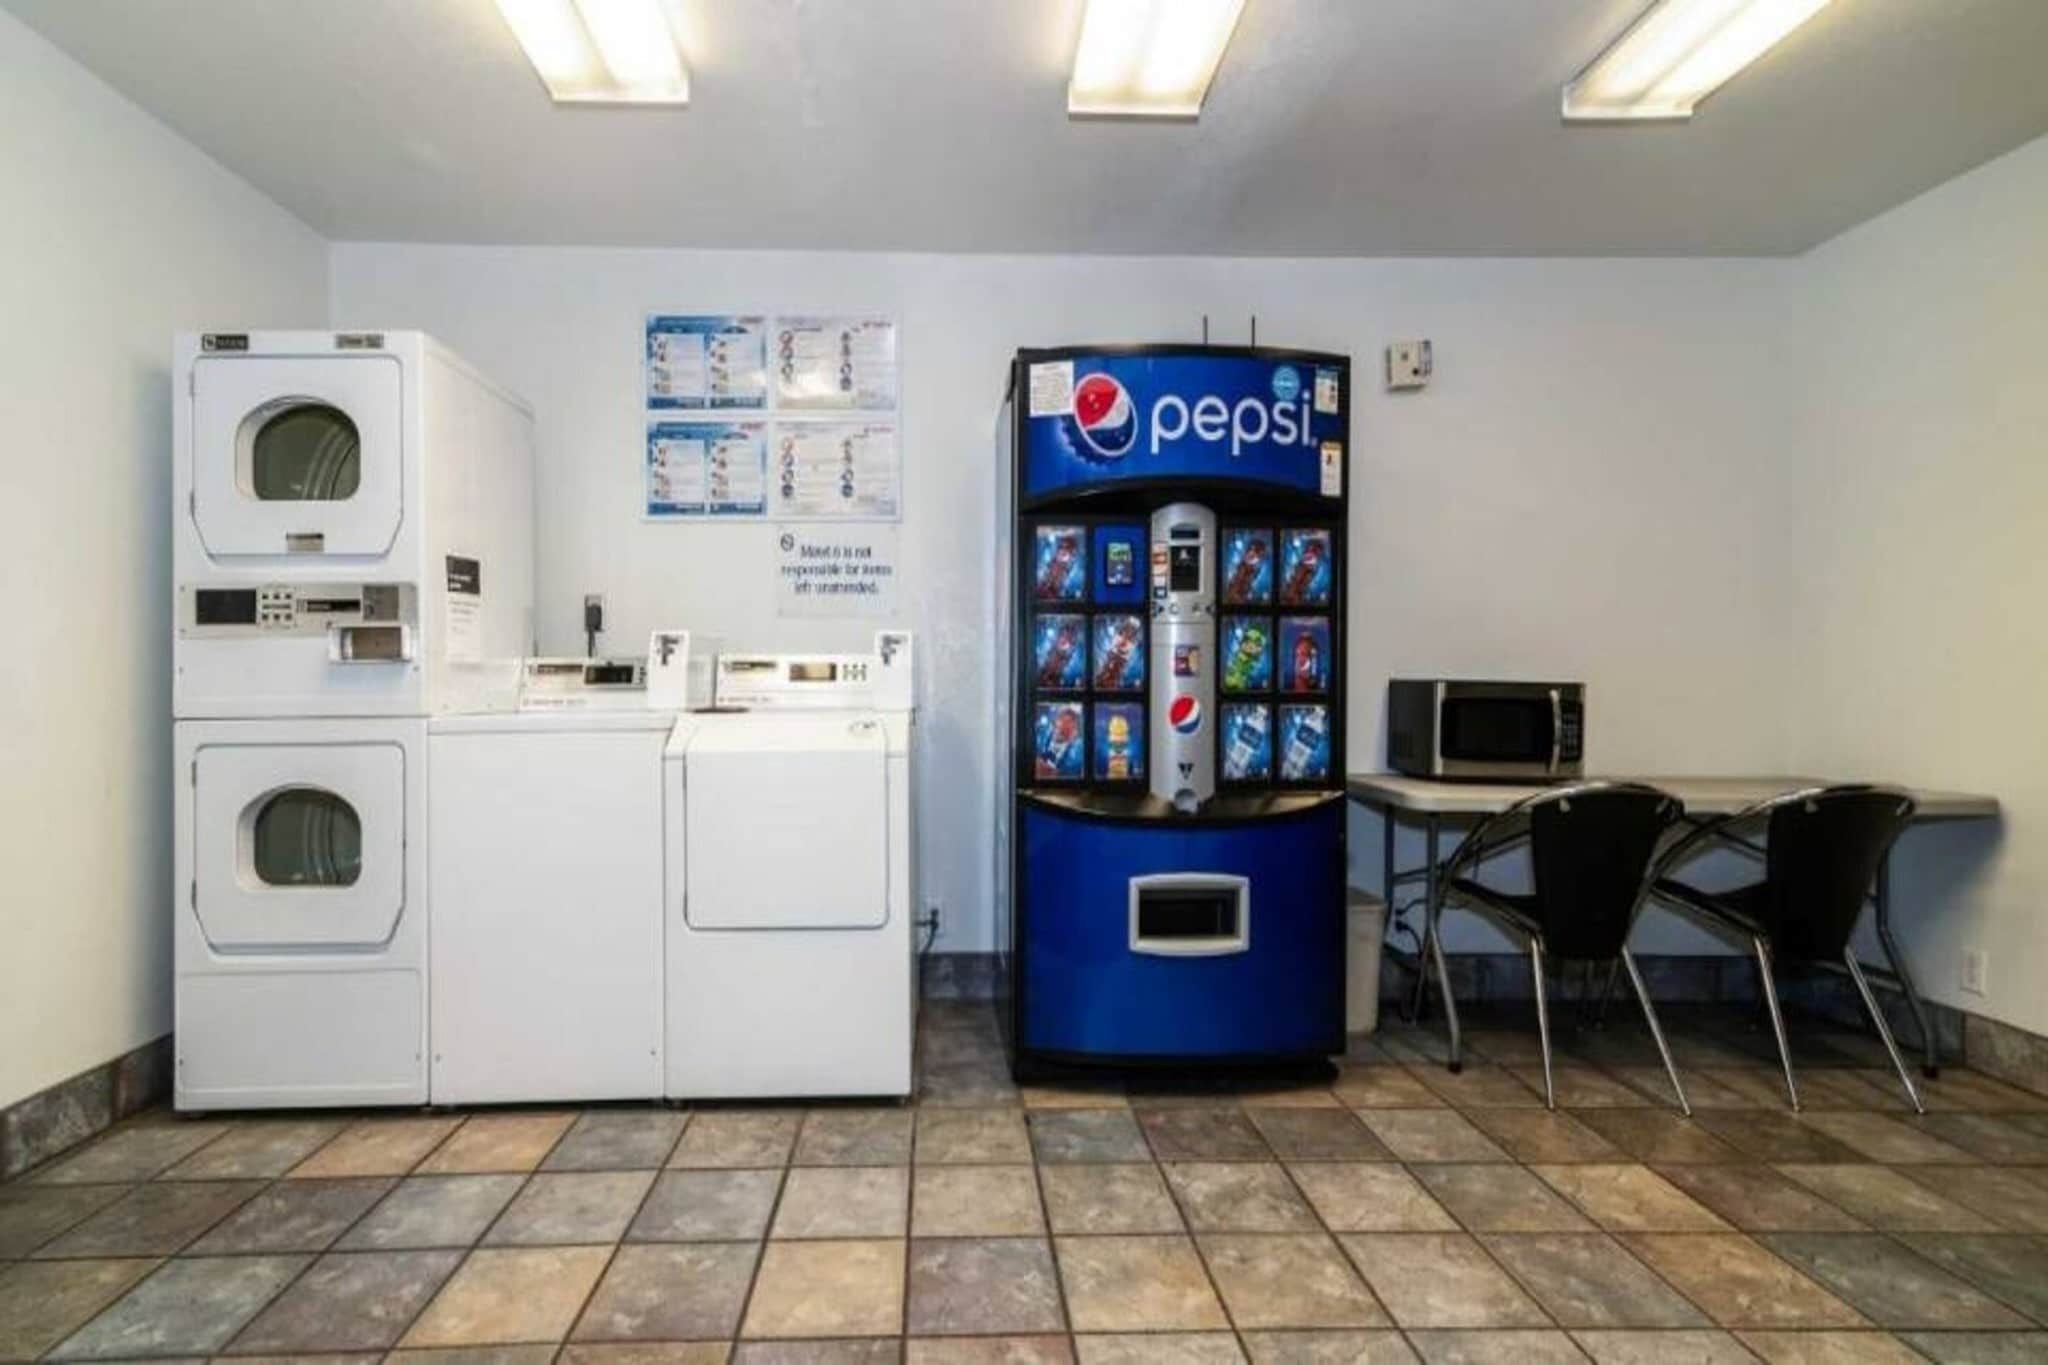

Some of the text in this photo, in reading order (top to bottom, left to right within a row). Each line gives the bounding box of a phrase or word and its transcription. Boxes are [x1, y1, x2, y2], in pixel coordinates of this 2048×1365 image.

[1151, 389, 1311, 455] pepsi
[781, 563, 839, 579] responsible
[845, 563, 858, 575] for
